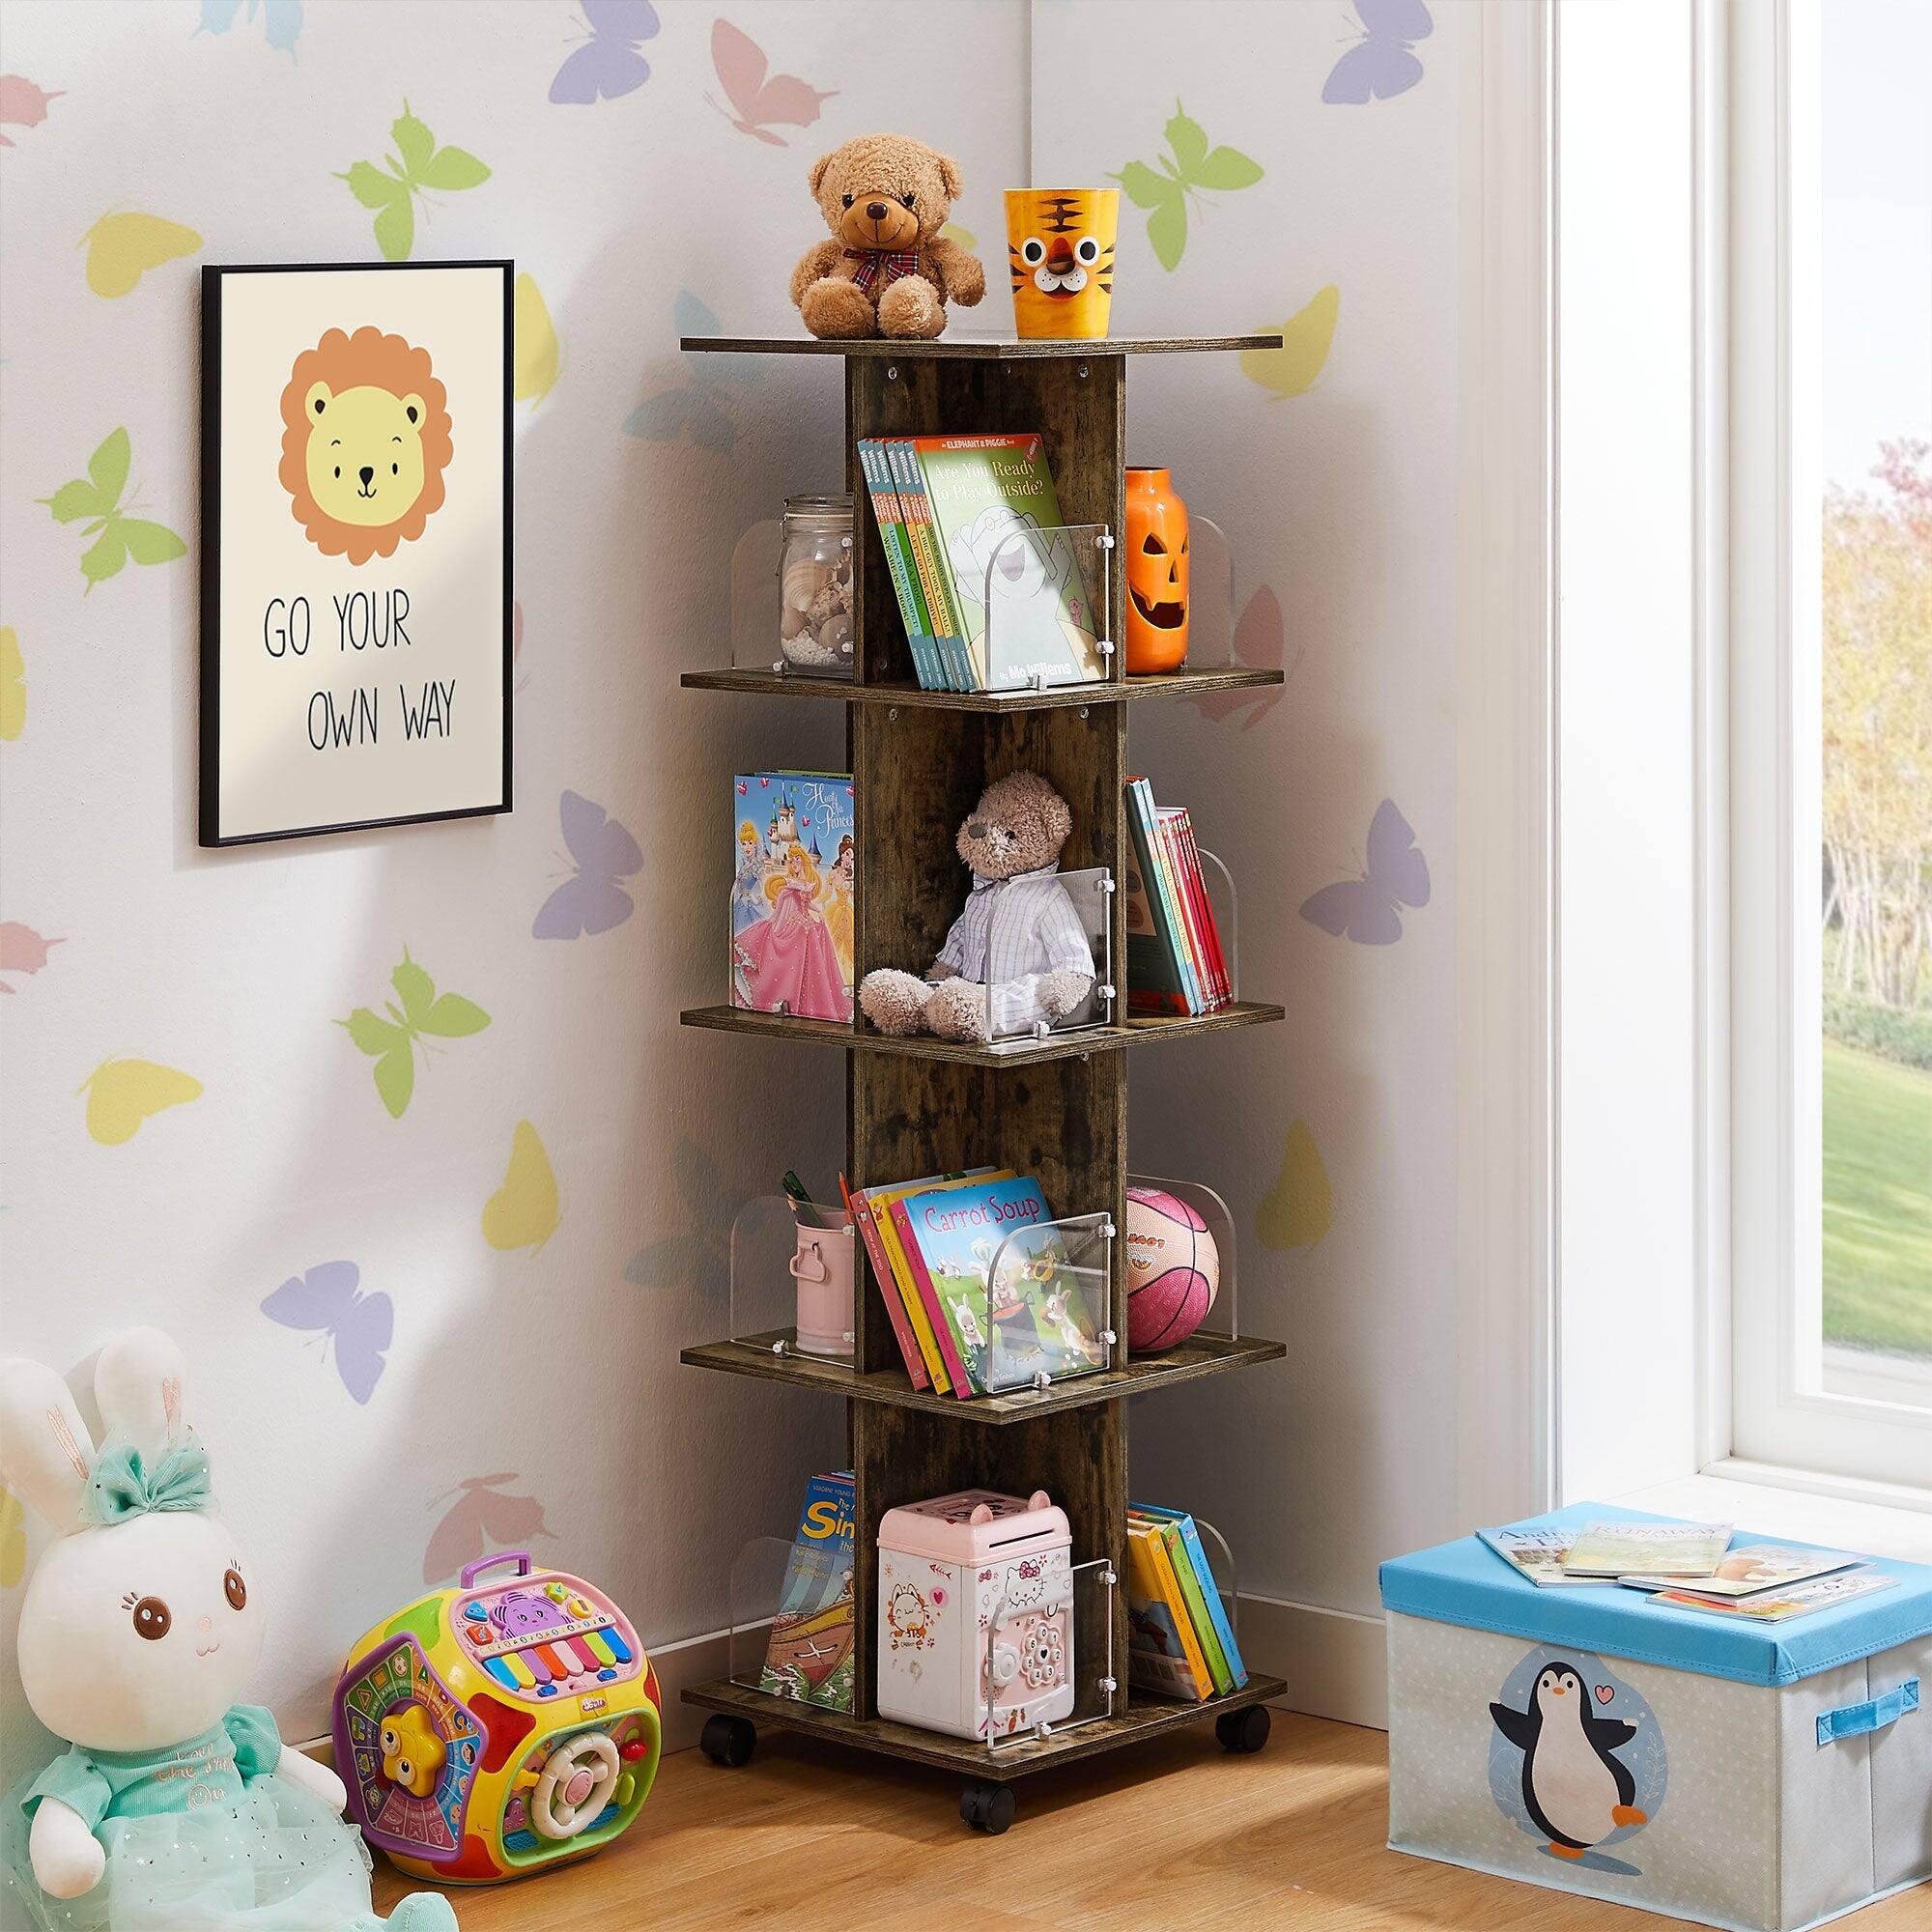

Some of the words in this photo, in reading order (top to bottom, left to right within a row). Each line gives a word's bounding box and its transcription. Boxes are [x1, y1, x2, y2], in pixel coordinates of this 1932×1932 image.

[947, 440, 980, 449] ELEPHANT
[985, 438, 1007, 447] PIGGIE
[859, 449, 874, 483] Willems
[867, 449, 881, 483] Willems
[875, 449, 891, 484] Willems
[887, 450, 902, 483] Willems
[897, 450, 912, 484] Willems
[906, 450, 922, 484] Willems
[935, 464, 959, 480] Are
[963, 463, 989, 480] You
[991, 460, 1036, 479] Ready
[934, 487, 949, 501] to
[952, 483, 981, 503] Play
[986, 479, 1044, 498] Outside?
[264, 596, 310, 658] GO
[333, 588, 412, 651] YOUR
[1008, 665, 1026, 679] Mo
[1026, 662, 1072, 678] Willems
[308, 687, 378, 751] OWN
[400, 679, 456, 741] WAY
[924, 1203, 990, 1233] Carrot
[989, 1196, 1040, 1224] Soup
